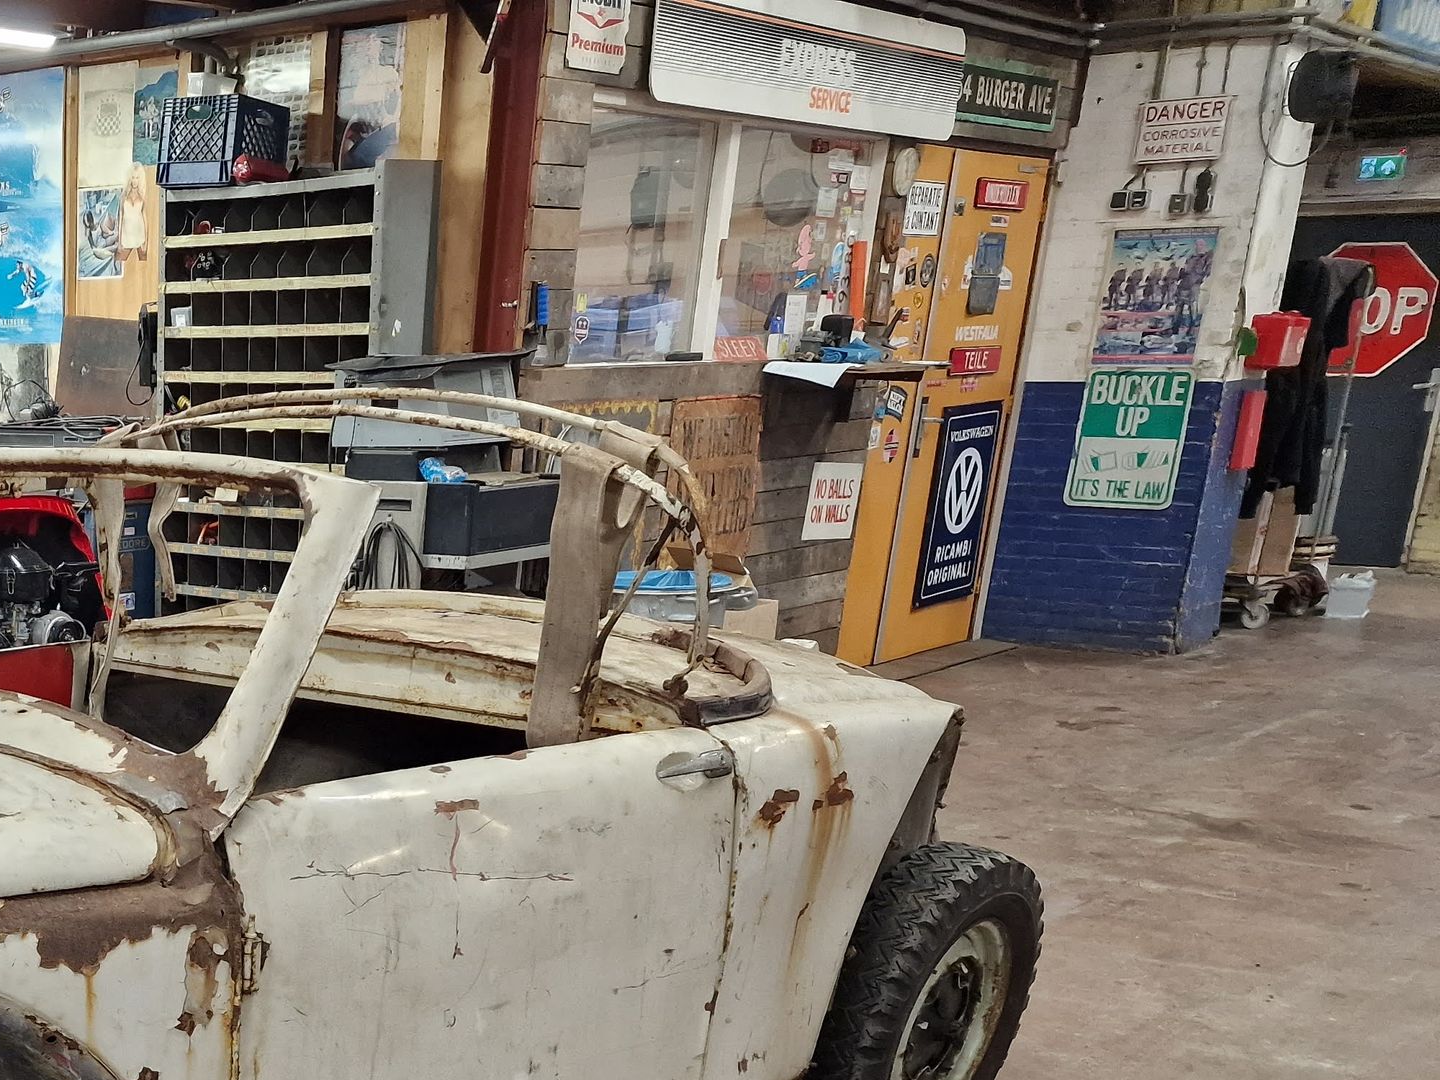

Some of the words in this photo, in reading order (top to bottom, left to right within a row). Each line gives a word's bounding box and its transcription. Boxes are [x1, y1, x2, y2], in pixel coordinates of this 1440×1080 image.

[571, 33, 624, 56] Premium
[780, 39, 857, 87] EXPRESS
[809, 86, 852, 113] SERVICE
[976, 75, 1025, 110] BURGER
[1027, 84, 1053, 115] AVE.
[1145, 101, 1225, 123] DANGER
[1142, 127, 1221, 142] CORROSIVE
[1143, 143, 1213, 156] MATERIAL
[911, 211, 939, 230] CONTANT
[1360, 286, 1429, 335] OP
[955, 325, 999, 341] WESTFALIA
[717, 338, 757, 358] SLEEP
[964, 351, 989, 370] TEILE
[1091, 374, 1189, 406] BUCKLE
[1115, 406, 1150, 437] UP
[950, 425, 994, 442] VOLKSWAGEN
[814, 479, 827, 499] NO
[828, 479, 855, 499] BALLS
[1074, 479, 1100, 497] IT'S
[1105, 480, 1131, 498] THE
[1134, 481, 1166, 499] LAW
[810, 504, 824, 523] ON
[825, 504, 851, 523] WALLS
[934, 539, 972, 562] RICAMBI
[927, 560, 971, 586] ORIGINALI
